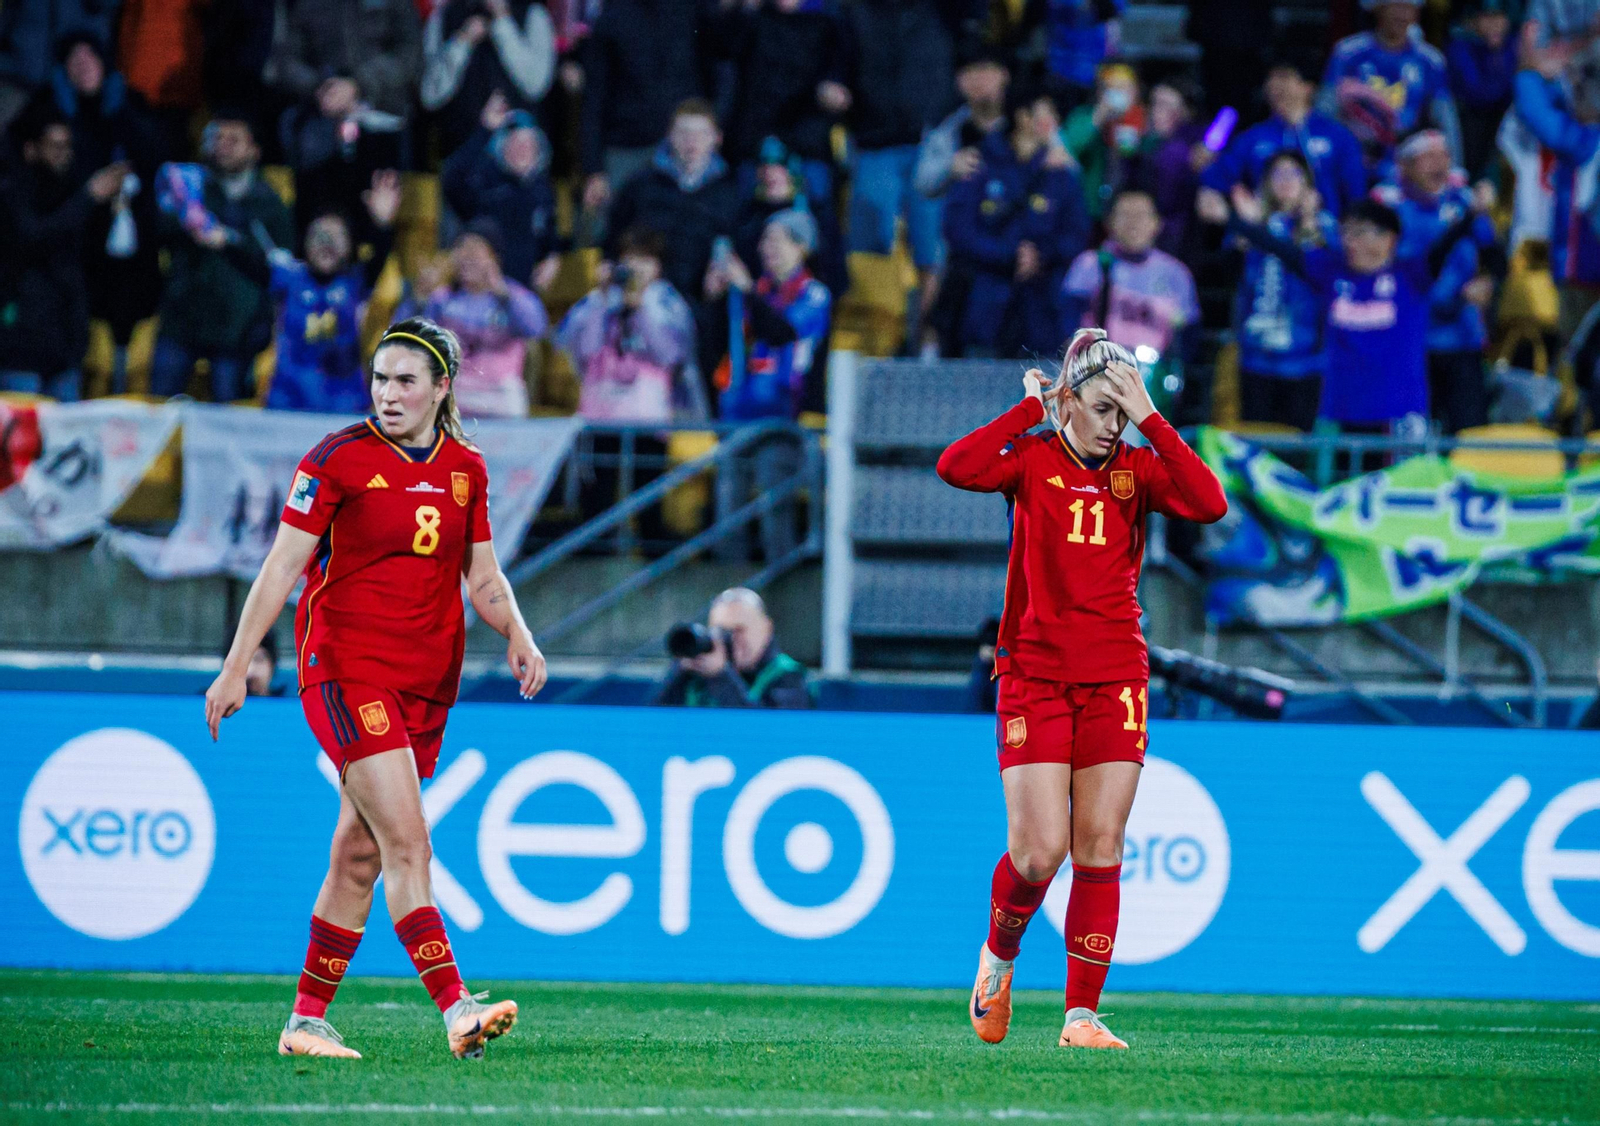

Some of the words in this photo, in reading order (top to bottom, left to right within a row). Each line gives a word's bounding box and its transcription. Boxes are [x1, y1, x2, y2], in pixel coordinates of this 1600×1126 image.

[412, 505, 441, 555] 8
[1067, 498, 1107, 546] 11
[1118, 686, 1147, 733] 11
[40, 808, 193, 859] xero
